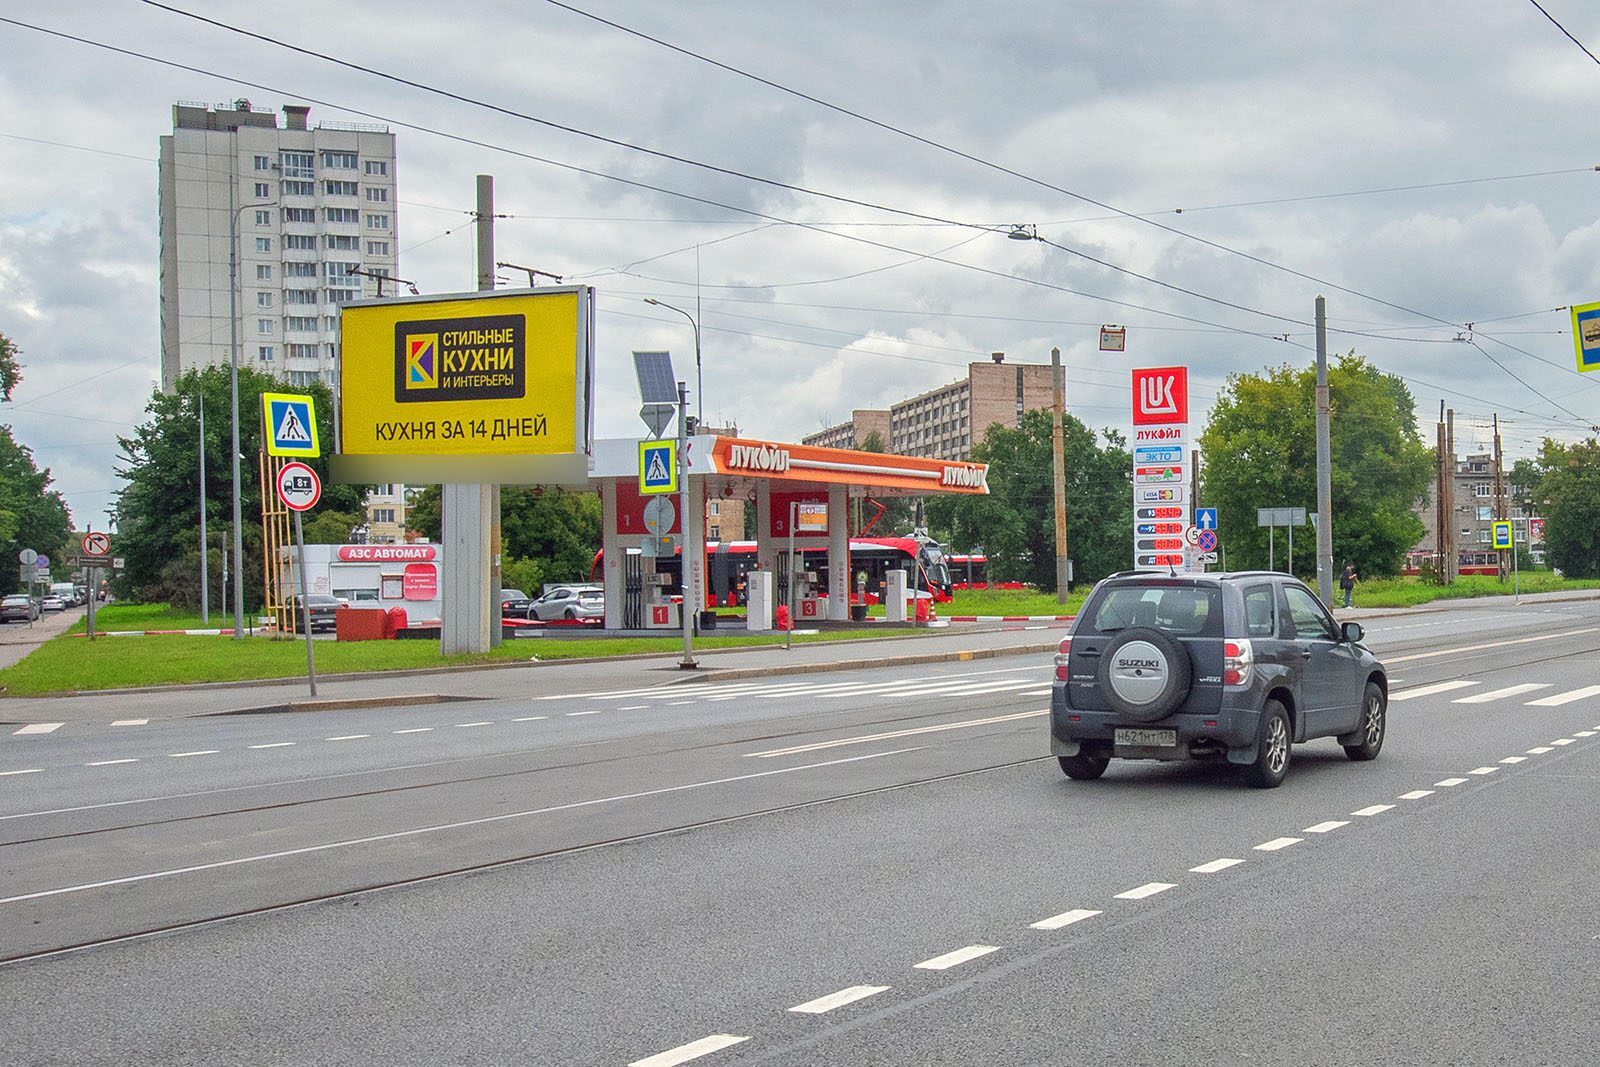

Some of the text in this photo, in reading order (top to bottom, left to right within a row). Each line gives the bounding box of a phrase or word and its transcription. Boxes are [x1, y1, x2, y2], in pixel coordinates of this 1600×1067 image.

[442, 328, 514, 346] СТИЛЬНЫЕ
[443, 347, 514, 373] КУХНИ
[443, 374, 514, 388] И ИНТЕРЬЕРЫ
[376, 413, 547, 441] КУХНЯ ЗА 14 ДНЕЙ
[729, 443, 790, 472] ЛУКОЙЛ
[1145, 452, 1172, 461] ЭКТО
[348, 549, 428, 559] АЗС АВТОМАТ
[805, 602, 813, 615] 3
[656, 609, 664, 623] 1
[1118, 659, 1160, 668] SUZUKI
